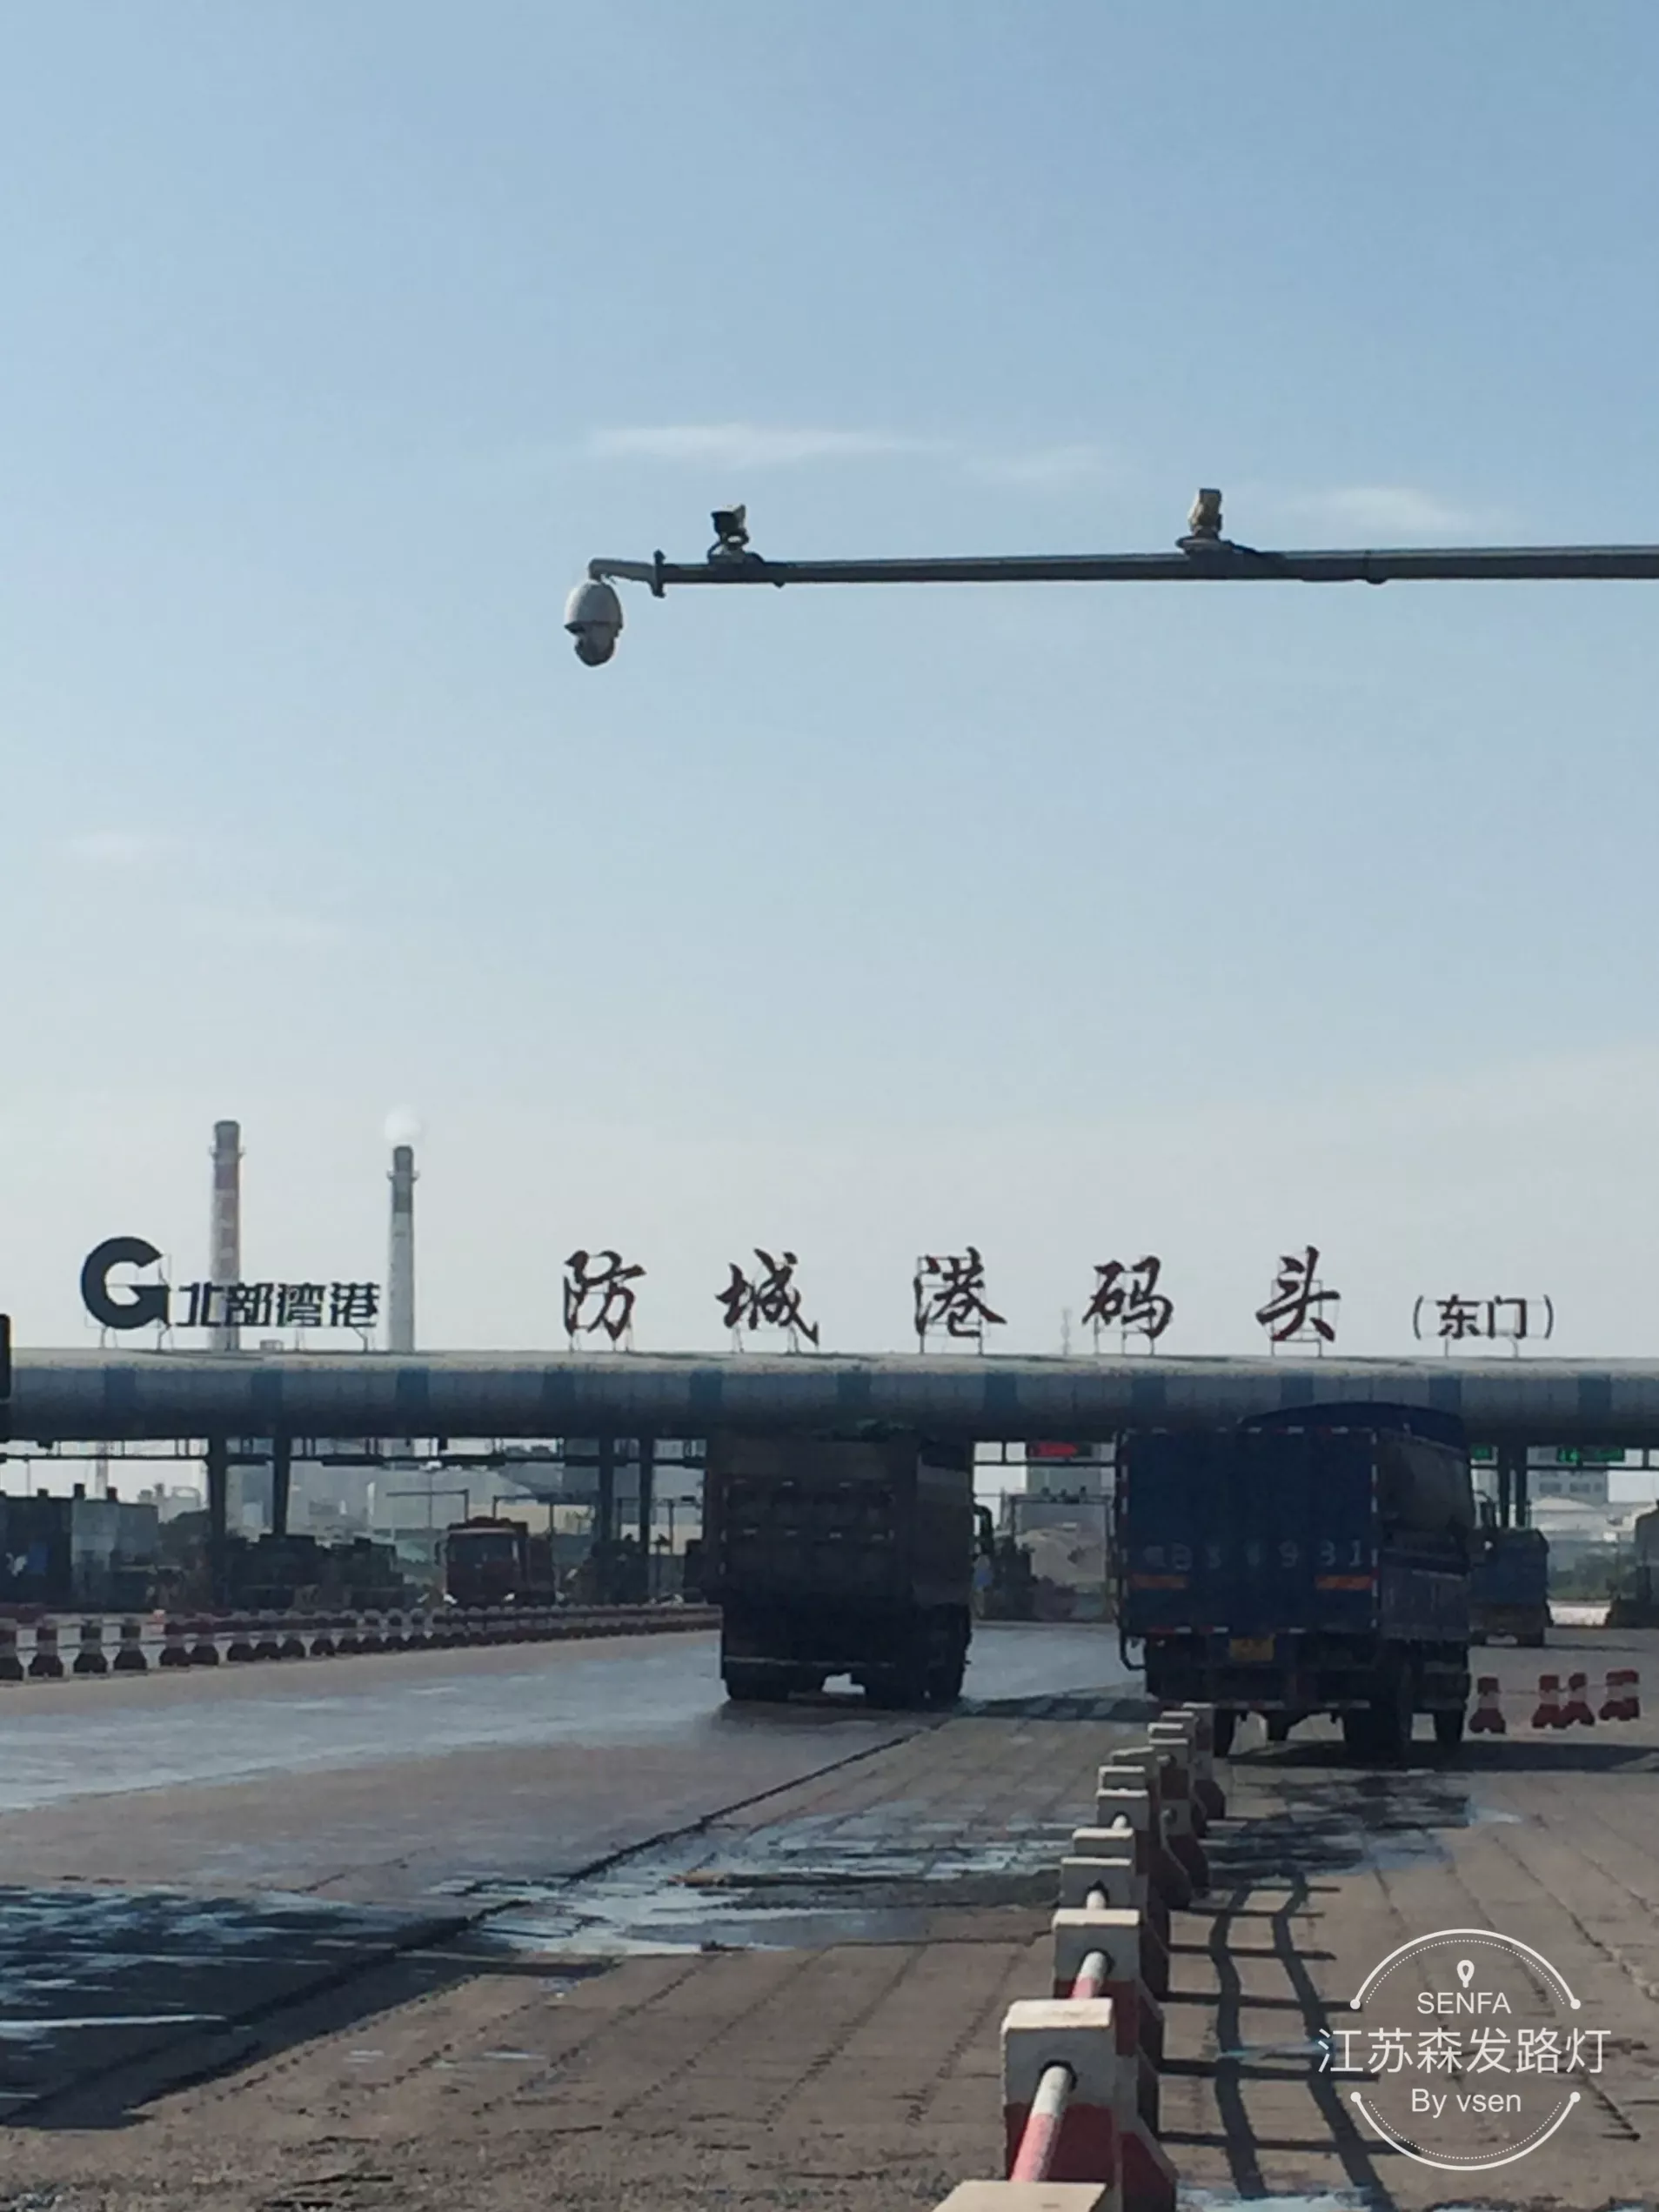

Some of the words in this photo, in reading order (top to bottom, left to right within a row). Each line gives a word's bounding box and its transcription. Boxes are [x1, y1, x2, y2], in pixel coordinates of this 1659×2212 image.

[176, 1281, 381, 1328] 北部湾港
[563, 1246, 1341, 1346] 防城港码头
